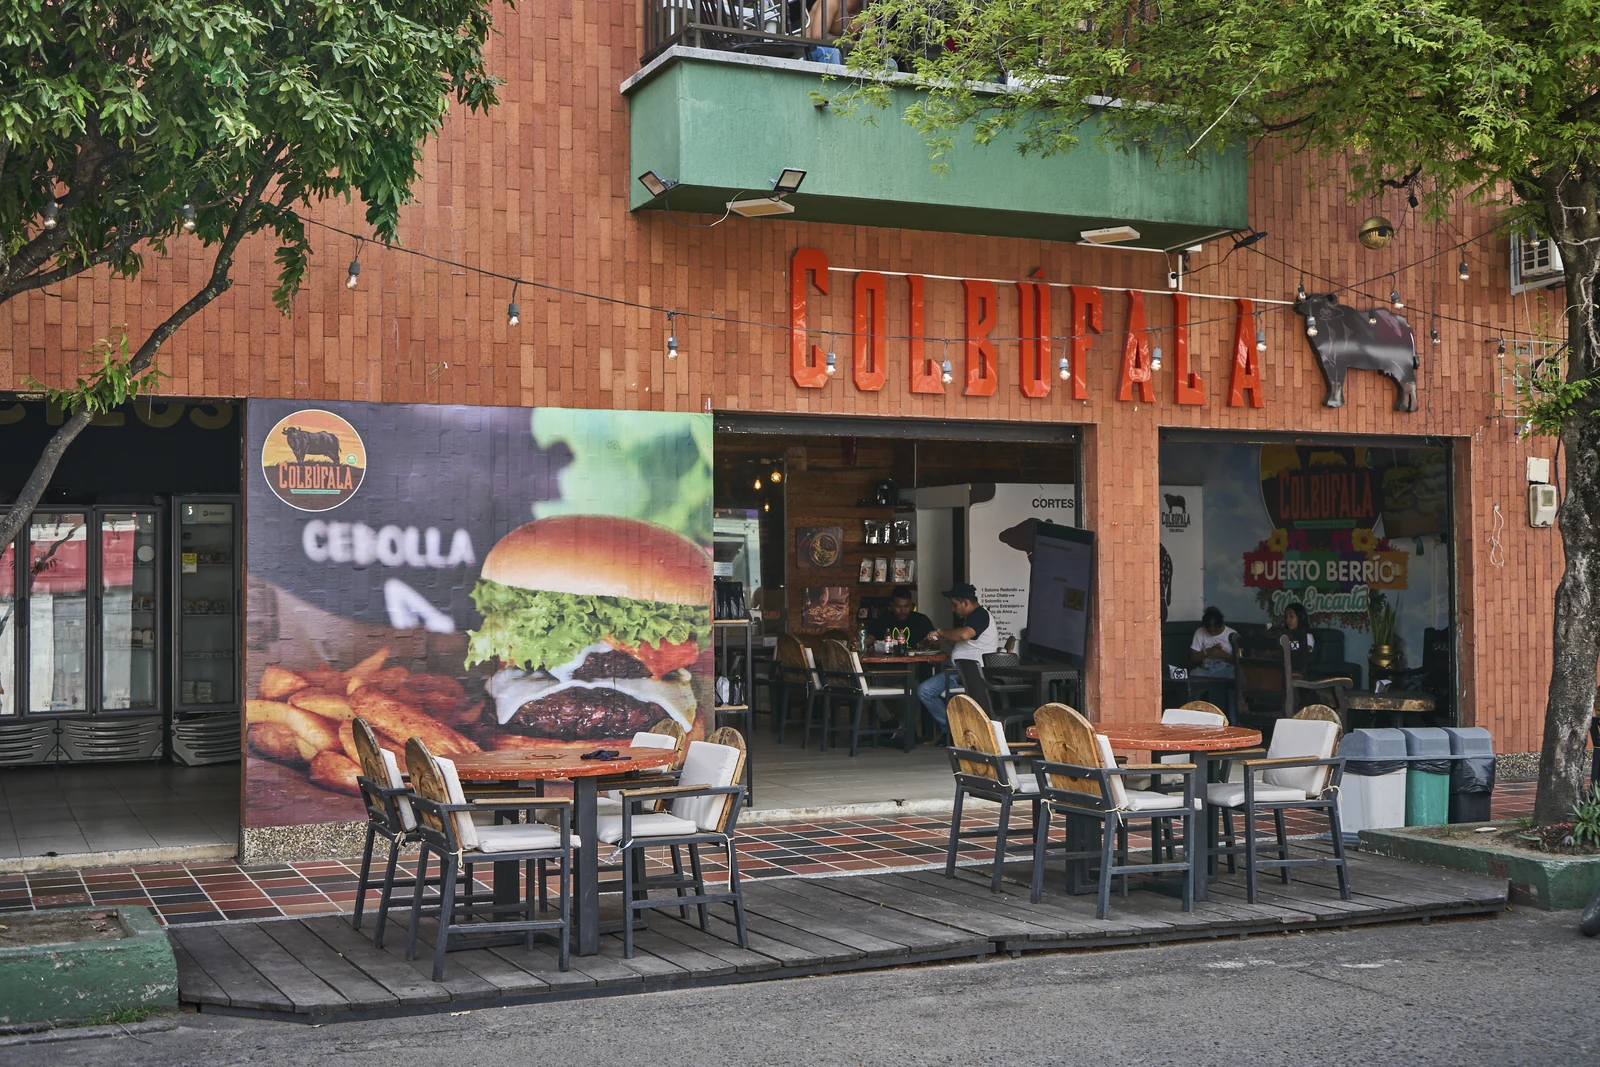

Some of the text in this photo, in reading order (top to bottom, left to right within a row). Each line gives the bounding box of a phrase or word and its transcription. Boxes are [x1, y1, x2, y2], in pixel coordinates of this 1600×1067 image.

[790, 248, 1265, 408] COLBÚFALA
[279, 462, 353, 489] COLBÚFALA
[1031, 498, 1075, 509] CORTES
[1279, 469, 1375, 520] COLBÚFALA
[302, 519, 476, 567] CEBOLLA
[1252, 554, 1397, 583] PUERTO BERRÍO
[1303, 584, 1371, 615] Encanta
